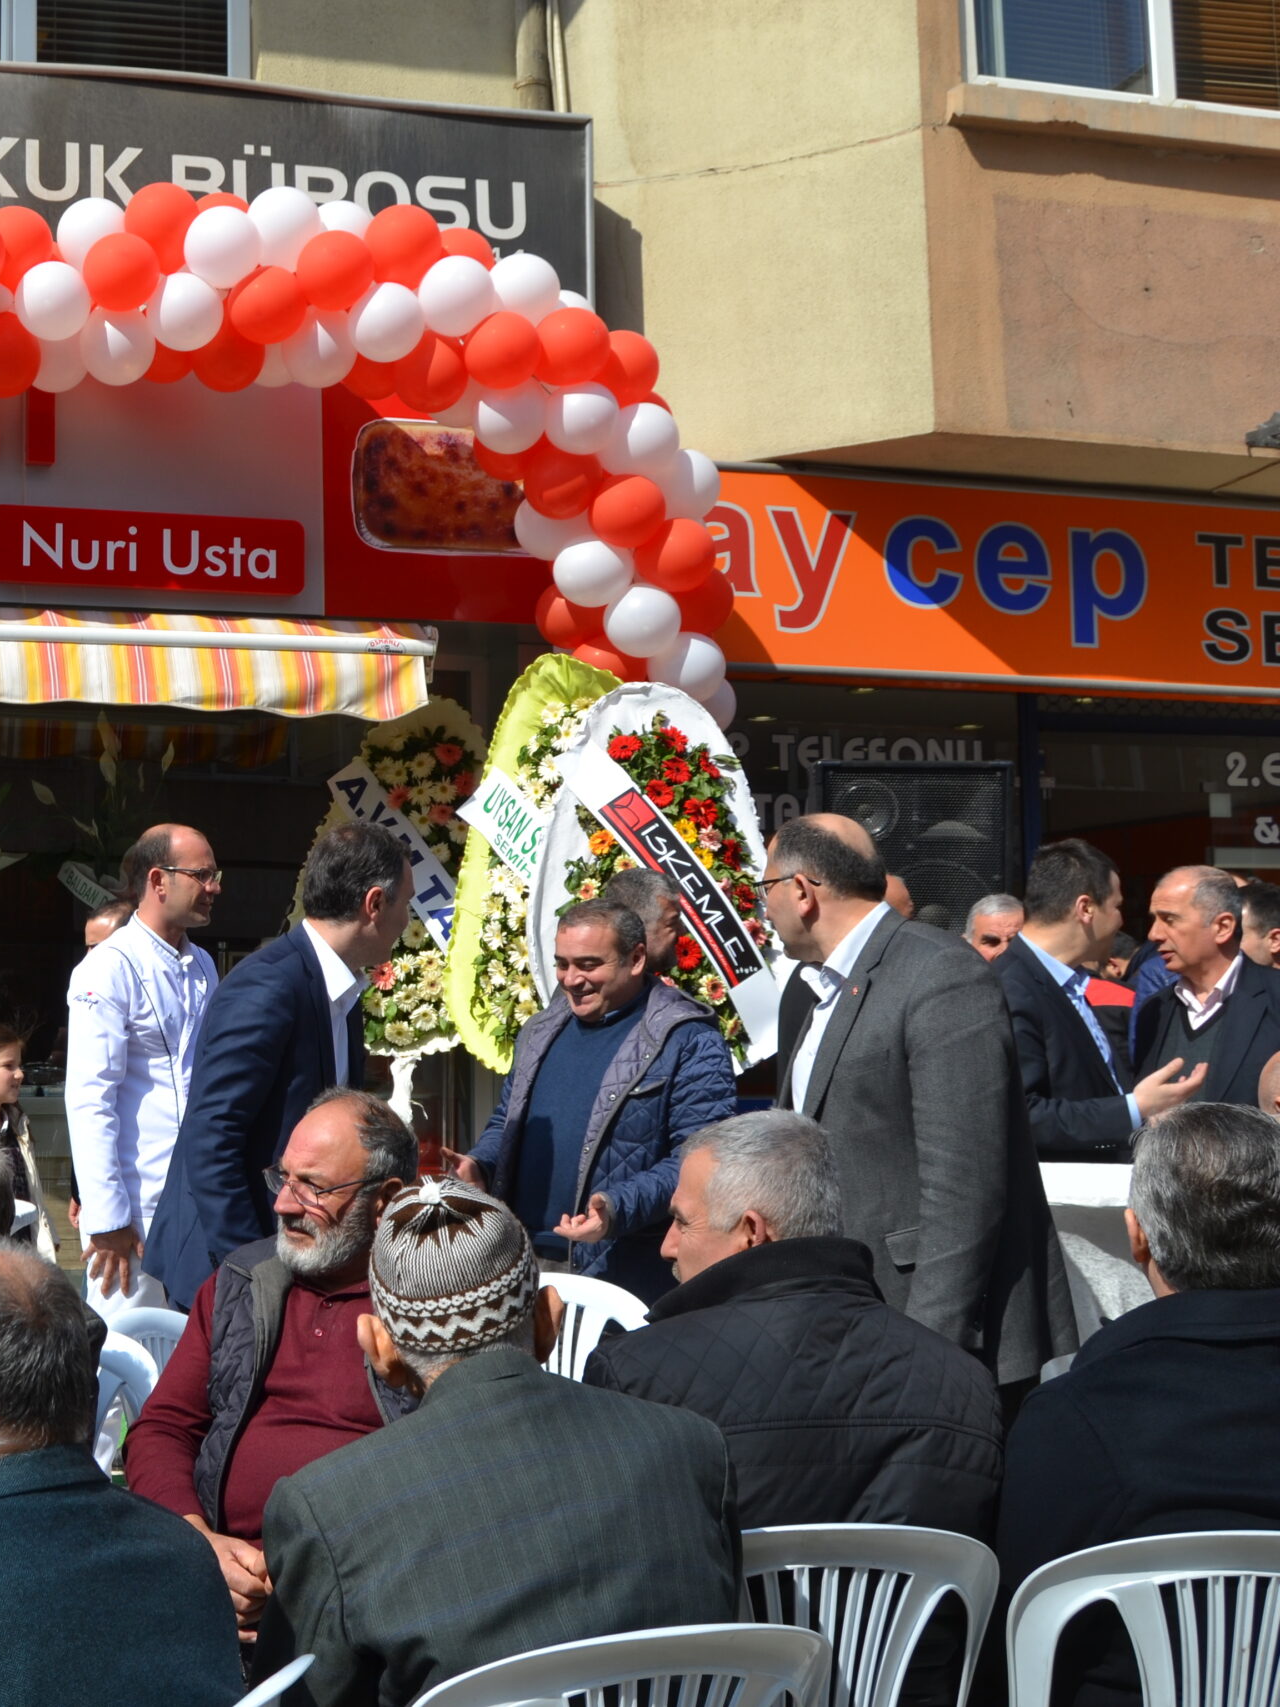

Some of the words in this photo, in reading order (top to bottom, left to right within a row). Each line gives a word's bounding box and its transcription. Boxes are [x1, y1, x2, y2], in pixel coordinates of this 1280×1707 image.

[21, 519, 138, 572] Nuri
[162, 527, 278, 580] Usta
[883, 515, 1148, 649] cep
[483, 784, 533, 844] UYSAN
